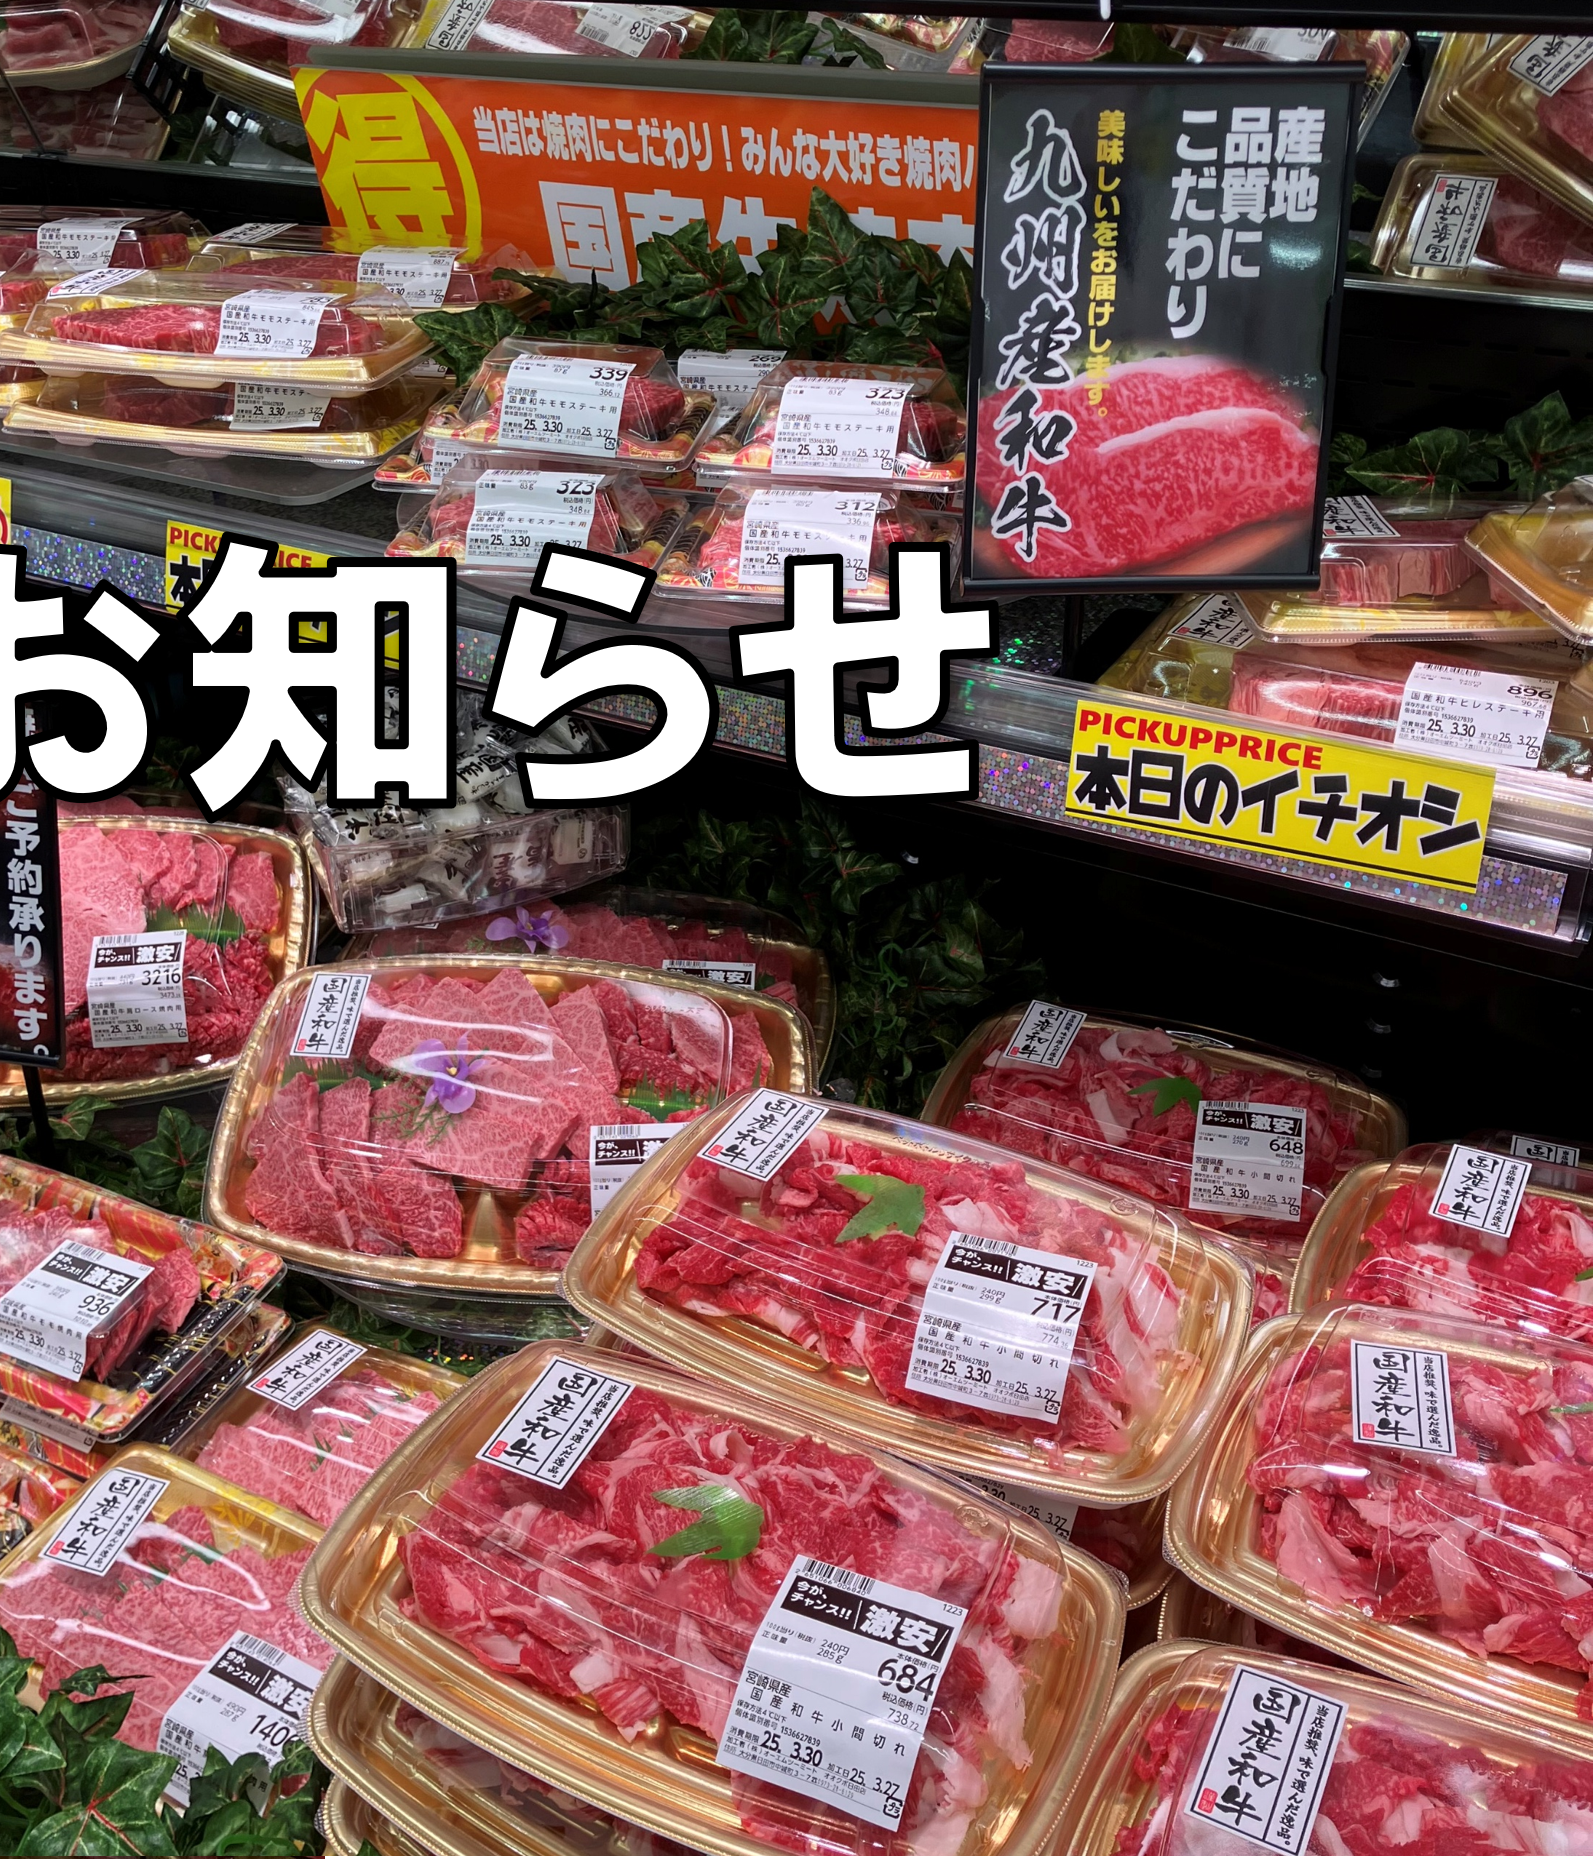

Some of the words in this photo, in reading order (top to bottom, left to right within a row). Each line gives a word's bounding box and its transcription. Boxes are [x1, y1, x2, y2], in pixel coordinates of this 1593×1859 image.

[472, 105, 974, 192] 当店は焼肉にこだわり！みんな大好き焼肉
[1269, 106, 1326, 223] 産地
[307, 91, 457, 249] 得
[1218, 106, 1274, 279] 品質に
[1166, 107, 1220, 340] こだわり
[1086, 108, 1126, 417] 美味しいをお届けします。
[990, 107, 1087, 563] 九州産和牛
[588, 366, 628, 381] 339
[509, 395, 618, 414] 国産和牛モモステーキ用
[556, 480, 596, 495] 323
[1410, 691, 1546, 720] 国産和牛ヒレステーキ用
[1506, 685, 1553, 699] 896
[1078, 708, 1324, 771] PICKUPPRICE
[1073, 744, 1482, 857] 本日のイチオシ
[136, 945, 175, 963] 激安
[141, 968, 182, 986] 3216
[306, 976, 350, 1051] 国産和牛
[1017, 1005, 1062, 1061] 国産和牛
[719, 1097, 799, 1164] 国産和牛
[1250, 1113, 1296, 1135] 激安
[1269, 1138, 1304, 1155] 648
[1200, 1164, 1297, 1184] 国産和牛小間切れ
[1448, 1155, 1501, 1222] 国産和牛
[954, 1247, 982, 1262] 今が、
[82, 1266, 132, 1295] 激安
[1011, 1263, 1076, 1296] 激安
[78, 1294, 116, 1317] 936
[1030, 1296, 1082, 1325] 717
[922, 1314, 963, 1333] 宮崎県産
[927, 1325, 1060, 1370] 国産和牛小間切れ
[954, 1352, 990, 1369] 1536627839
[265, 1338, 345, 1396] 国産和牛
[963, 1365, 992, 1386] 3.30
[1372, 1352, 1417, 1442] 国産和牛
[503, 1371, 599, 1466] 国産和牛
[61, 1475, 142, 1562] 国産和牛
[796, 1579, 828, 1600] 今が、
[790, 1592, 853, 1621] チャンス!!
[941, 1603, 964, 1617] 1223
[860, 1604, 939, 1654] 激安
[820, 1638, 850, 1657] 240円
[745, 1669, 793, 1700] 宮崎県産
[877, 1657, 937, 1702] 684
[750, 1686, 906, 1757] 国産和牛小間切れ
[780, 1724, 822, 1748] 1536627839
[729, 1725, 761, 1744] 消費期限
[789, 1740, 824, 1769] 3.30
[826, 1762, 851, 1779] 加工日
[873, 1776, 901, 1798] 3.27
[1214, 1685, 1303, 1828] 国産和牛
